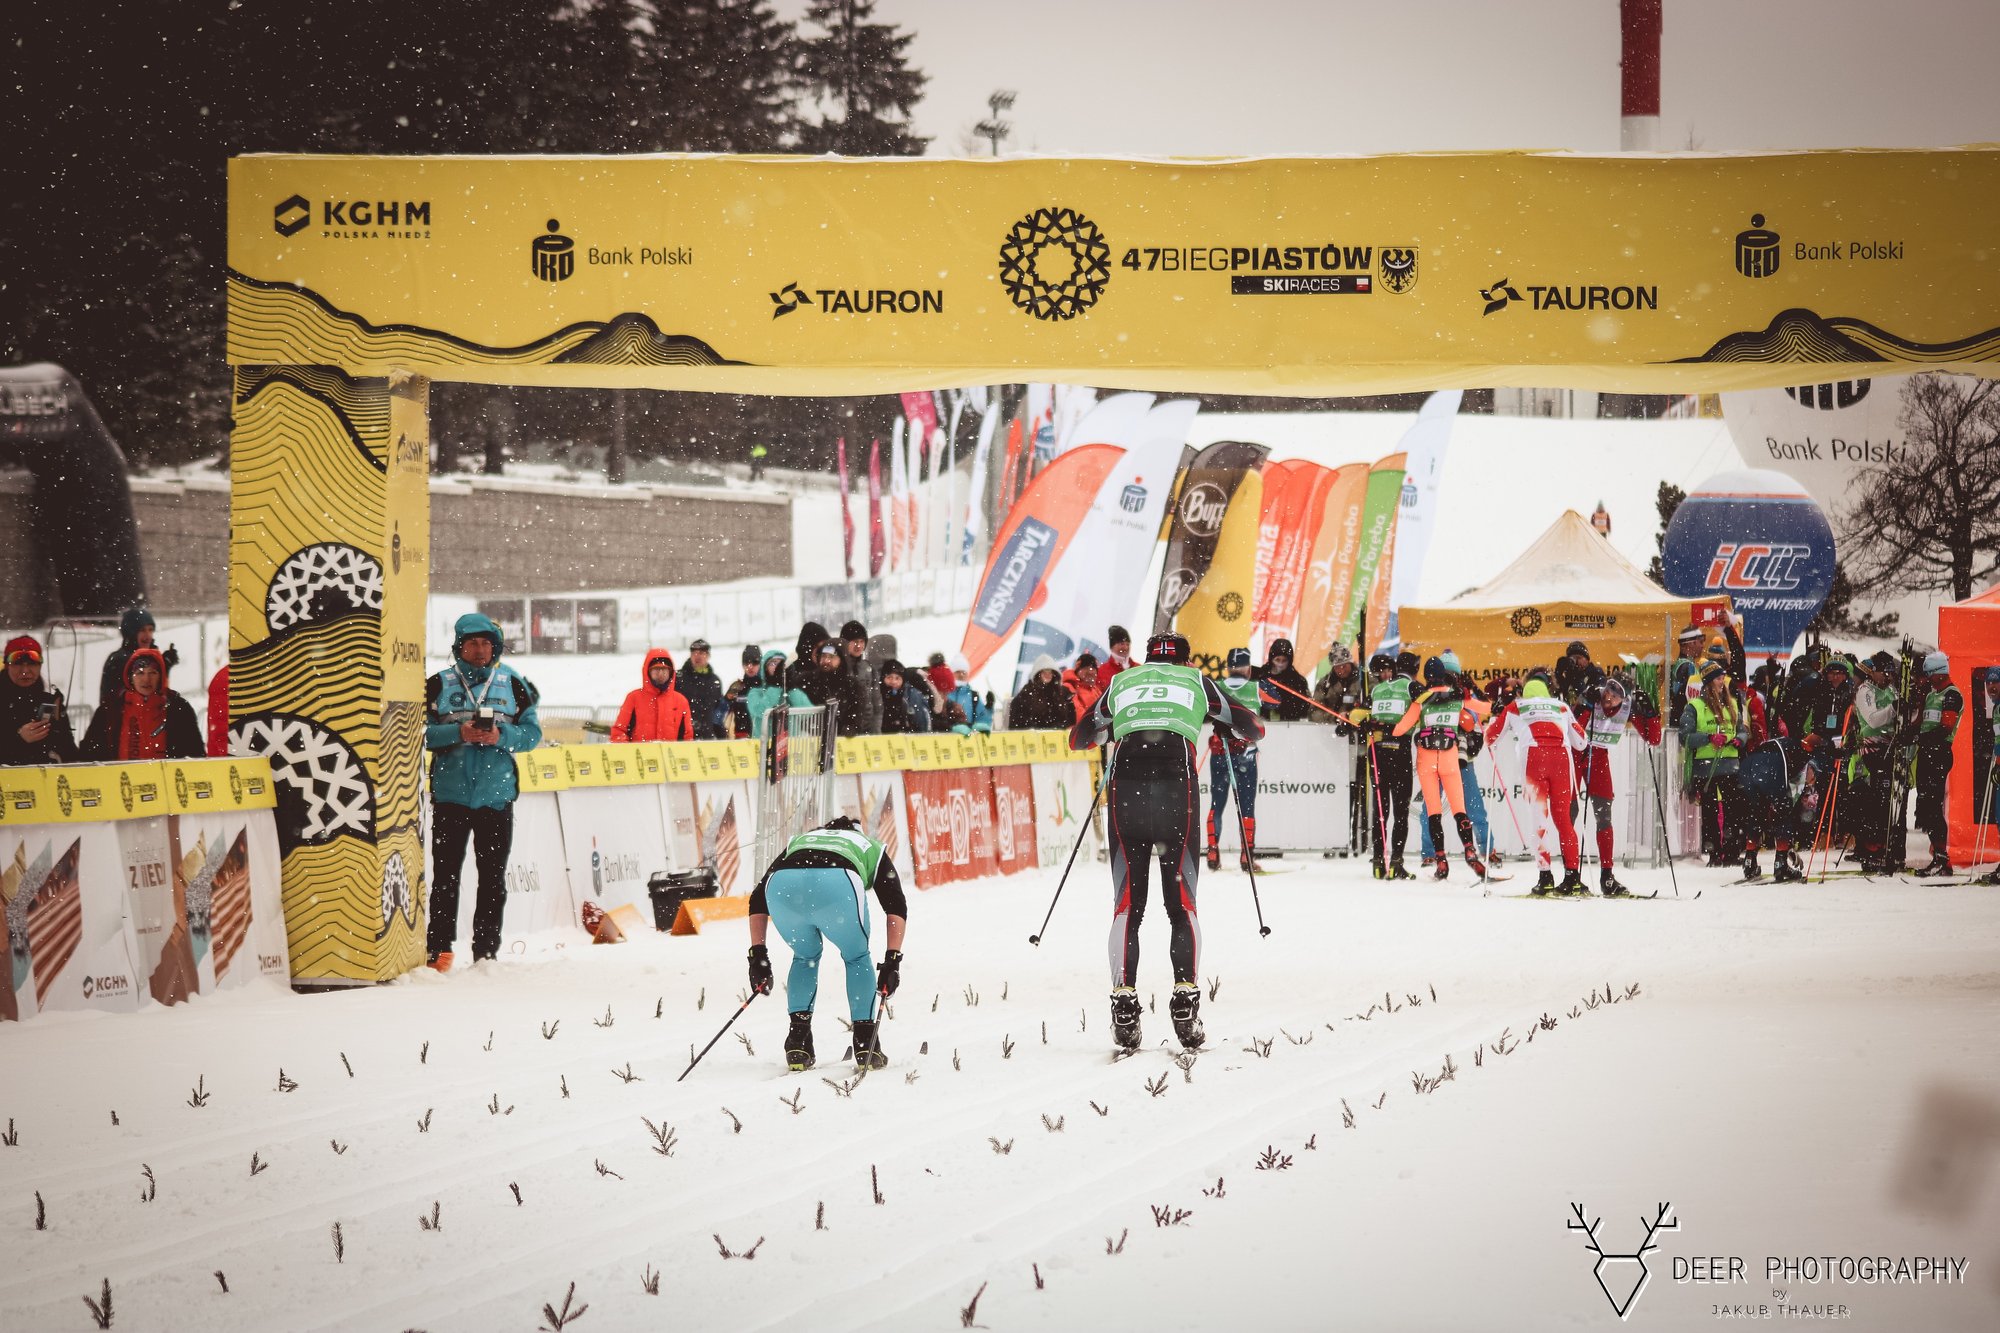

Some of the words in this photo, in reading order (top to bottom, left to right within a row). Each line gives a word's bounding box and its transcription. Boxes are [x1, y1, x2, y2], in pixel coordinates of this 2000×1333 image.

[324, 201, 431, 226] KGHM
[324, 231, 378, 239] POLSKA
[588, 247, 633, 265] Bank
[641, 247, 692, 265] Polski
[1795, 241, 1842, 260] Bank
[1849, 241, 1904, 260] Polski
[816, 290, 943, 313] TAURON
[1526, 286, 1658, 310] TAURON
[1766, 436, 1823, 461] Bank
[1831, 438, 1907, 463] Polski
[980, 526, 1051, 629] TARCZYŃSKI
[1342, 574, 1372, 648] zklarska
[1735, 598, 1764, 609] PKP
[1135, 687, 1168, 700] 79
[1377, 702, 1392, 711] 62
[1258, 781, 1336, 794] ństwowe
[1481, 788, 1507, 802] asy
[96, 975, 128, 991] KGHM
